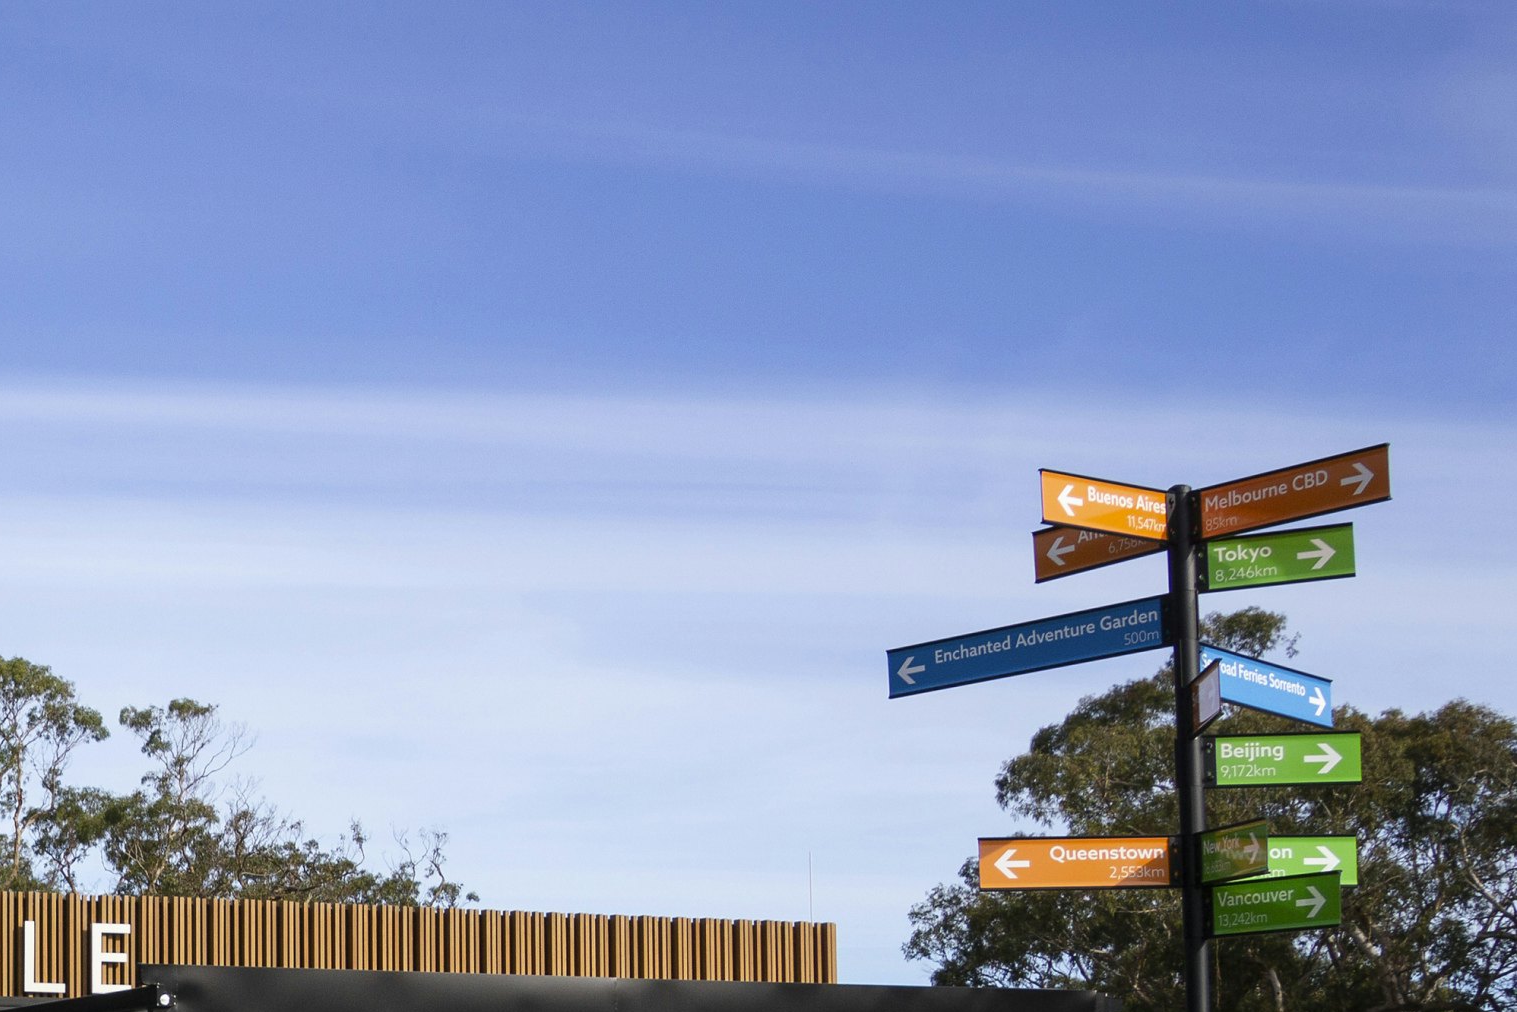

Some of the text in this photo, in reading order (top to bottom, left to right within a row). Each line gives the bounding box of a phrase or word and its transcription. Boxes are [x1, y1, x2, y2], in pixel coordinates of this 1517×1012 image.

[1205, 470, 1328, 512] Melbourne CBD
[1087, 486, 1166, 515] Buenos Aires
[1127, 514, 1167, 533] 11,547km
[1205, 516, 1238, 532] 85km
[1213, 544, 1272, 564] Tokyo
[1215, 565, 1278, 583] 8,246km
[934, 608, 1159, 664] Enchanted Adventure Garden
[1124, 630, 1161, 646] 500m
[1238, 663, 1268, 686] Ferries
[1268, 673, 1307, 696] Sorrento
[1220, 743, 1284, 761] Beijing
[1220, 765, 1277, 779] 9,172km
[1049, 845, 1165, 864] Queenstown
[1109, 866, 1165, 880] 2,553km
[1217, 889, 1294, 907] Vancouver
[1218, 913, 1268, 928] 13,242km
